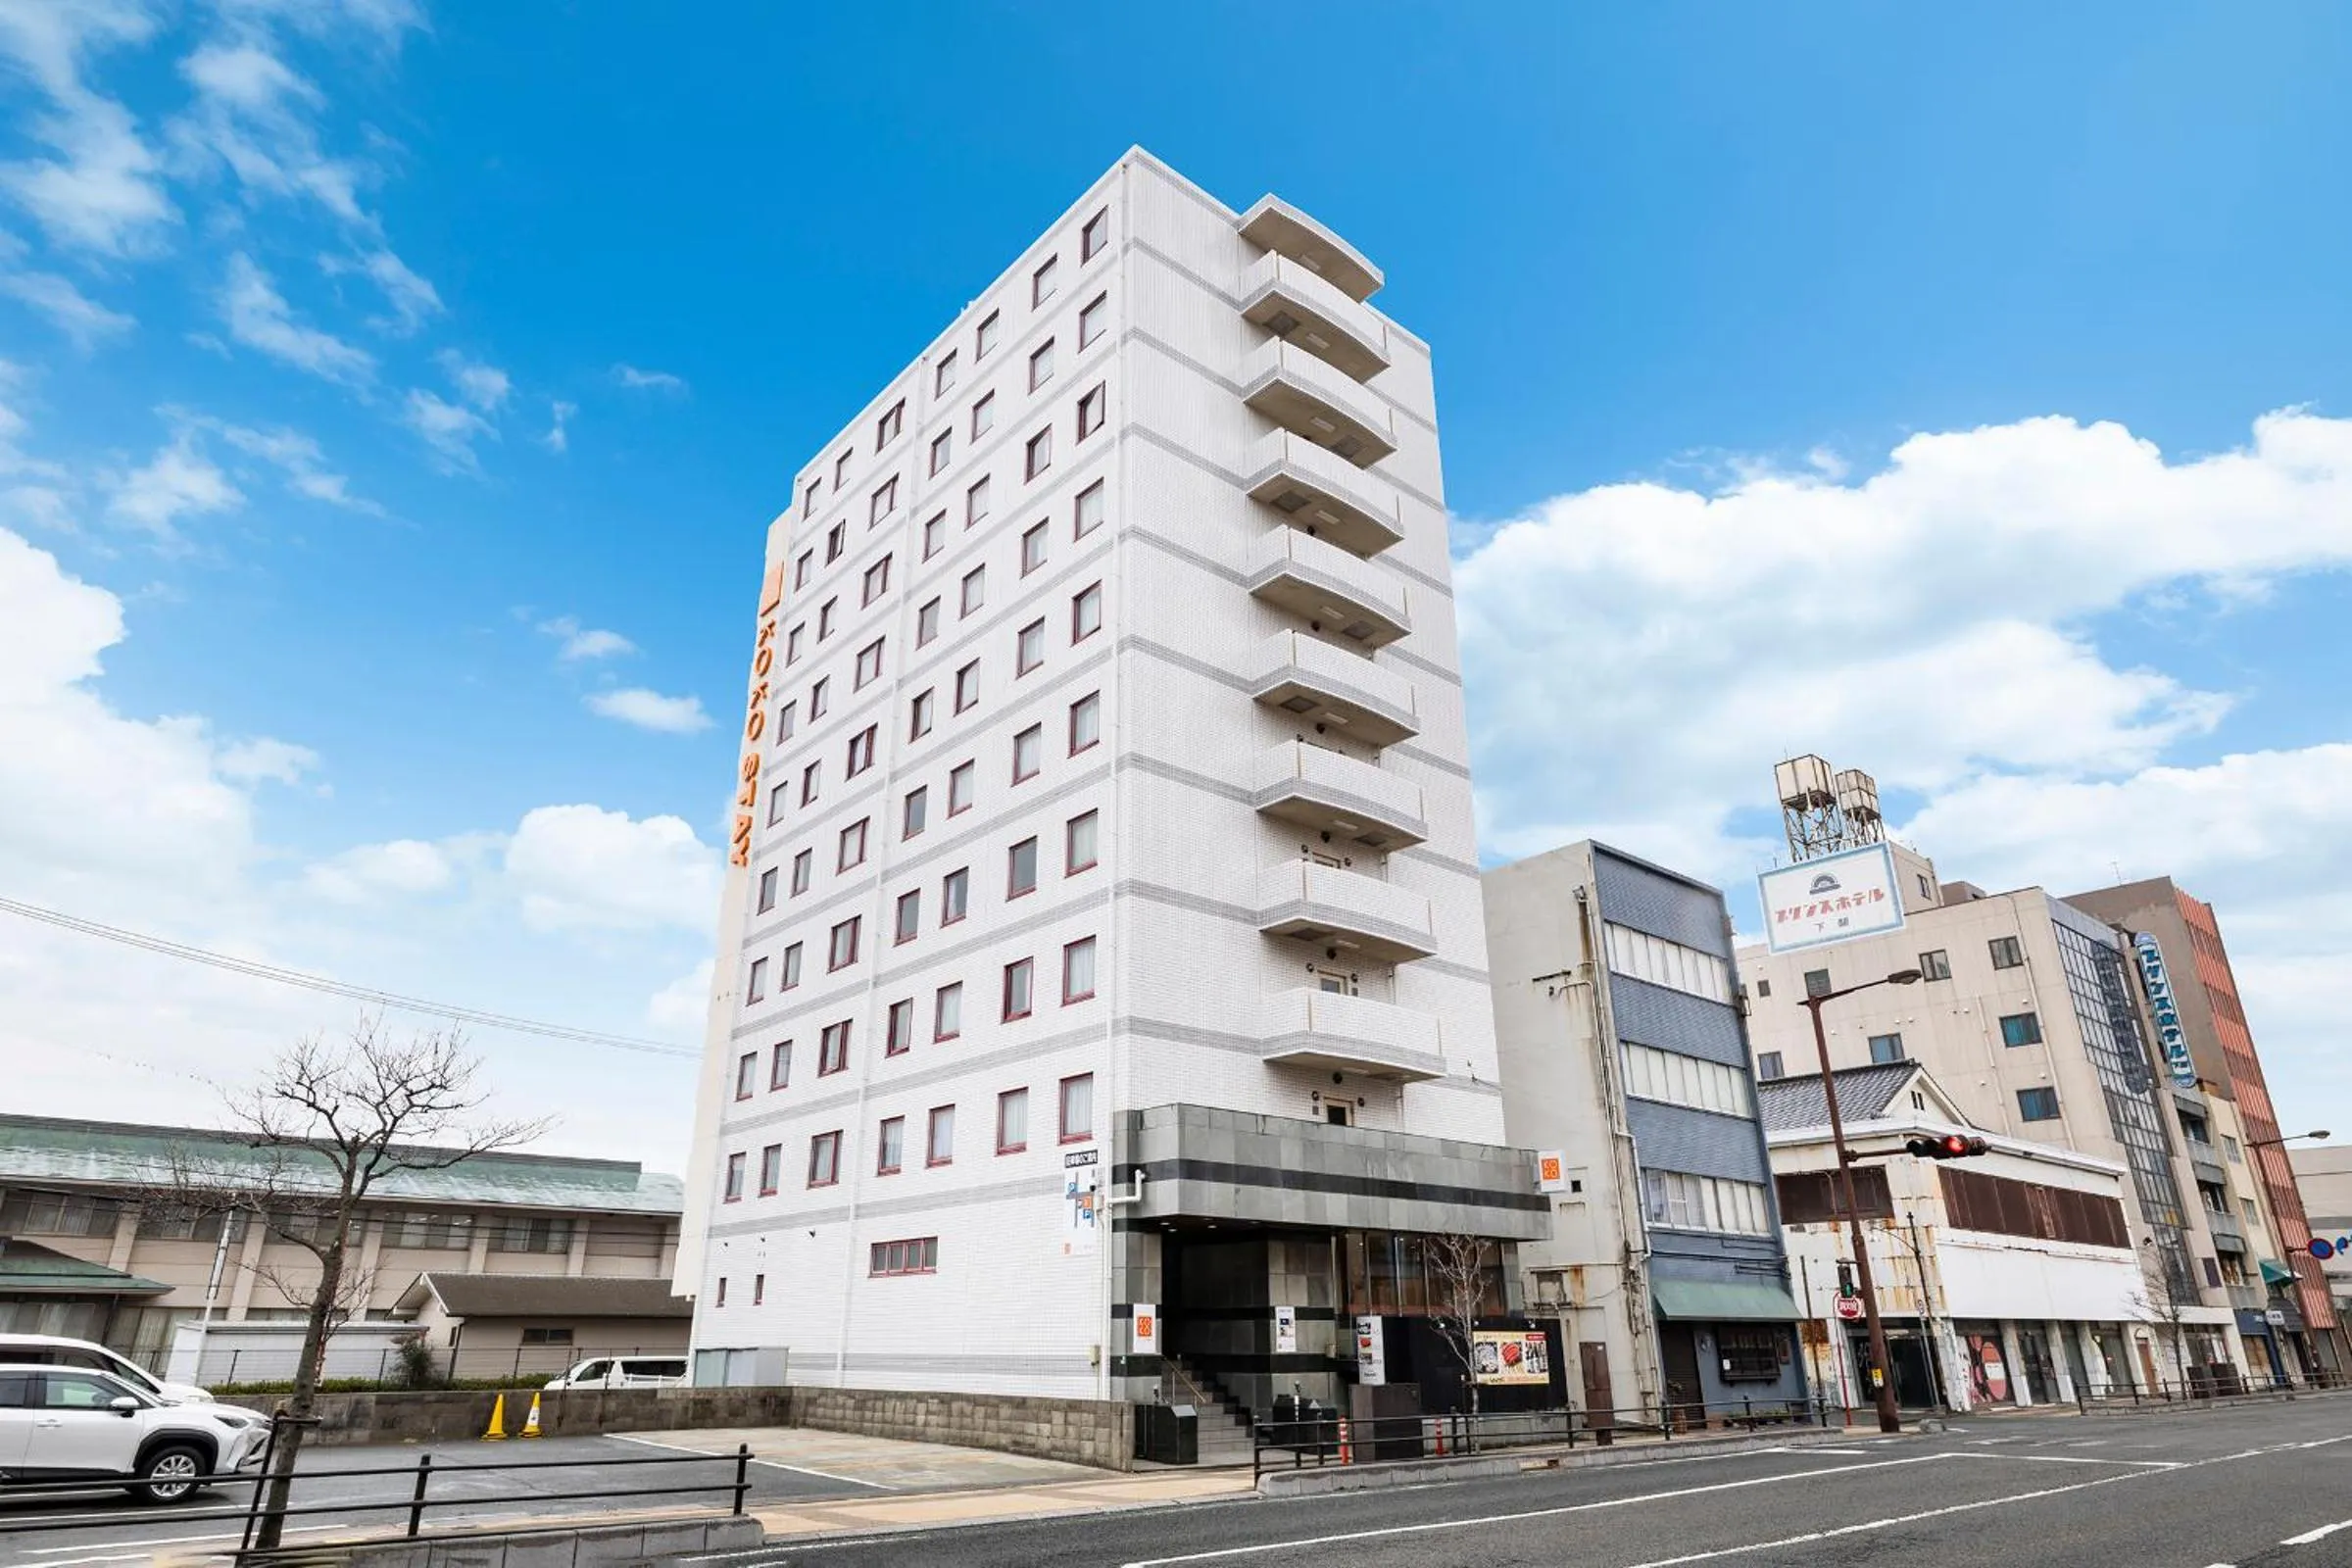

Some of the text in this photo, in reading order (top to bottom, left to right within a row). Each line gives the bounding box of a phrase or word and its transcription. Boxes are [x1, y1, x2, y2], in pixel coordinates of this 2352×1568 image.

[730, 618, 775, 867] KOKO STAY
[1775, 888, 1885, 923] プリンスホテル
